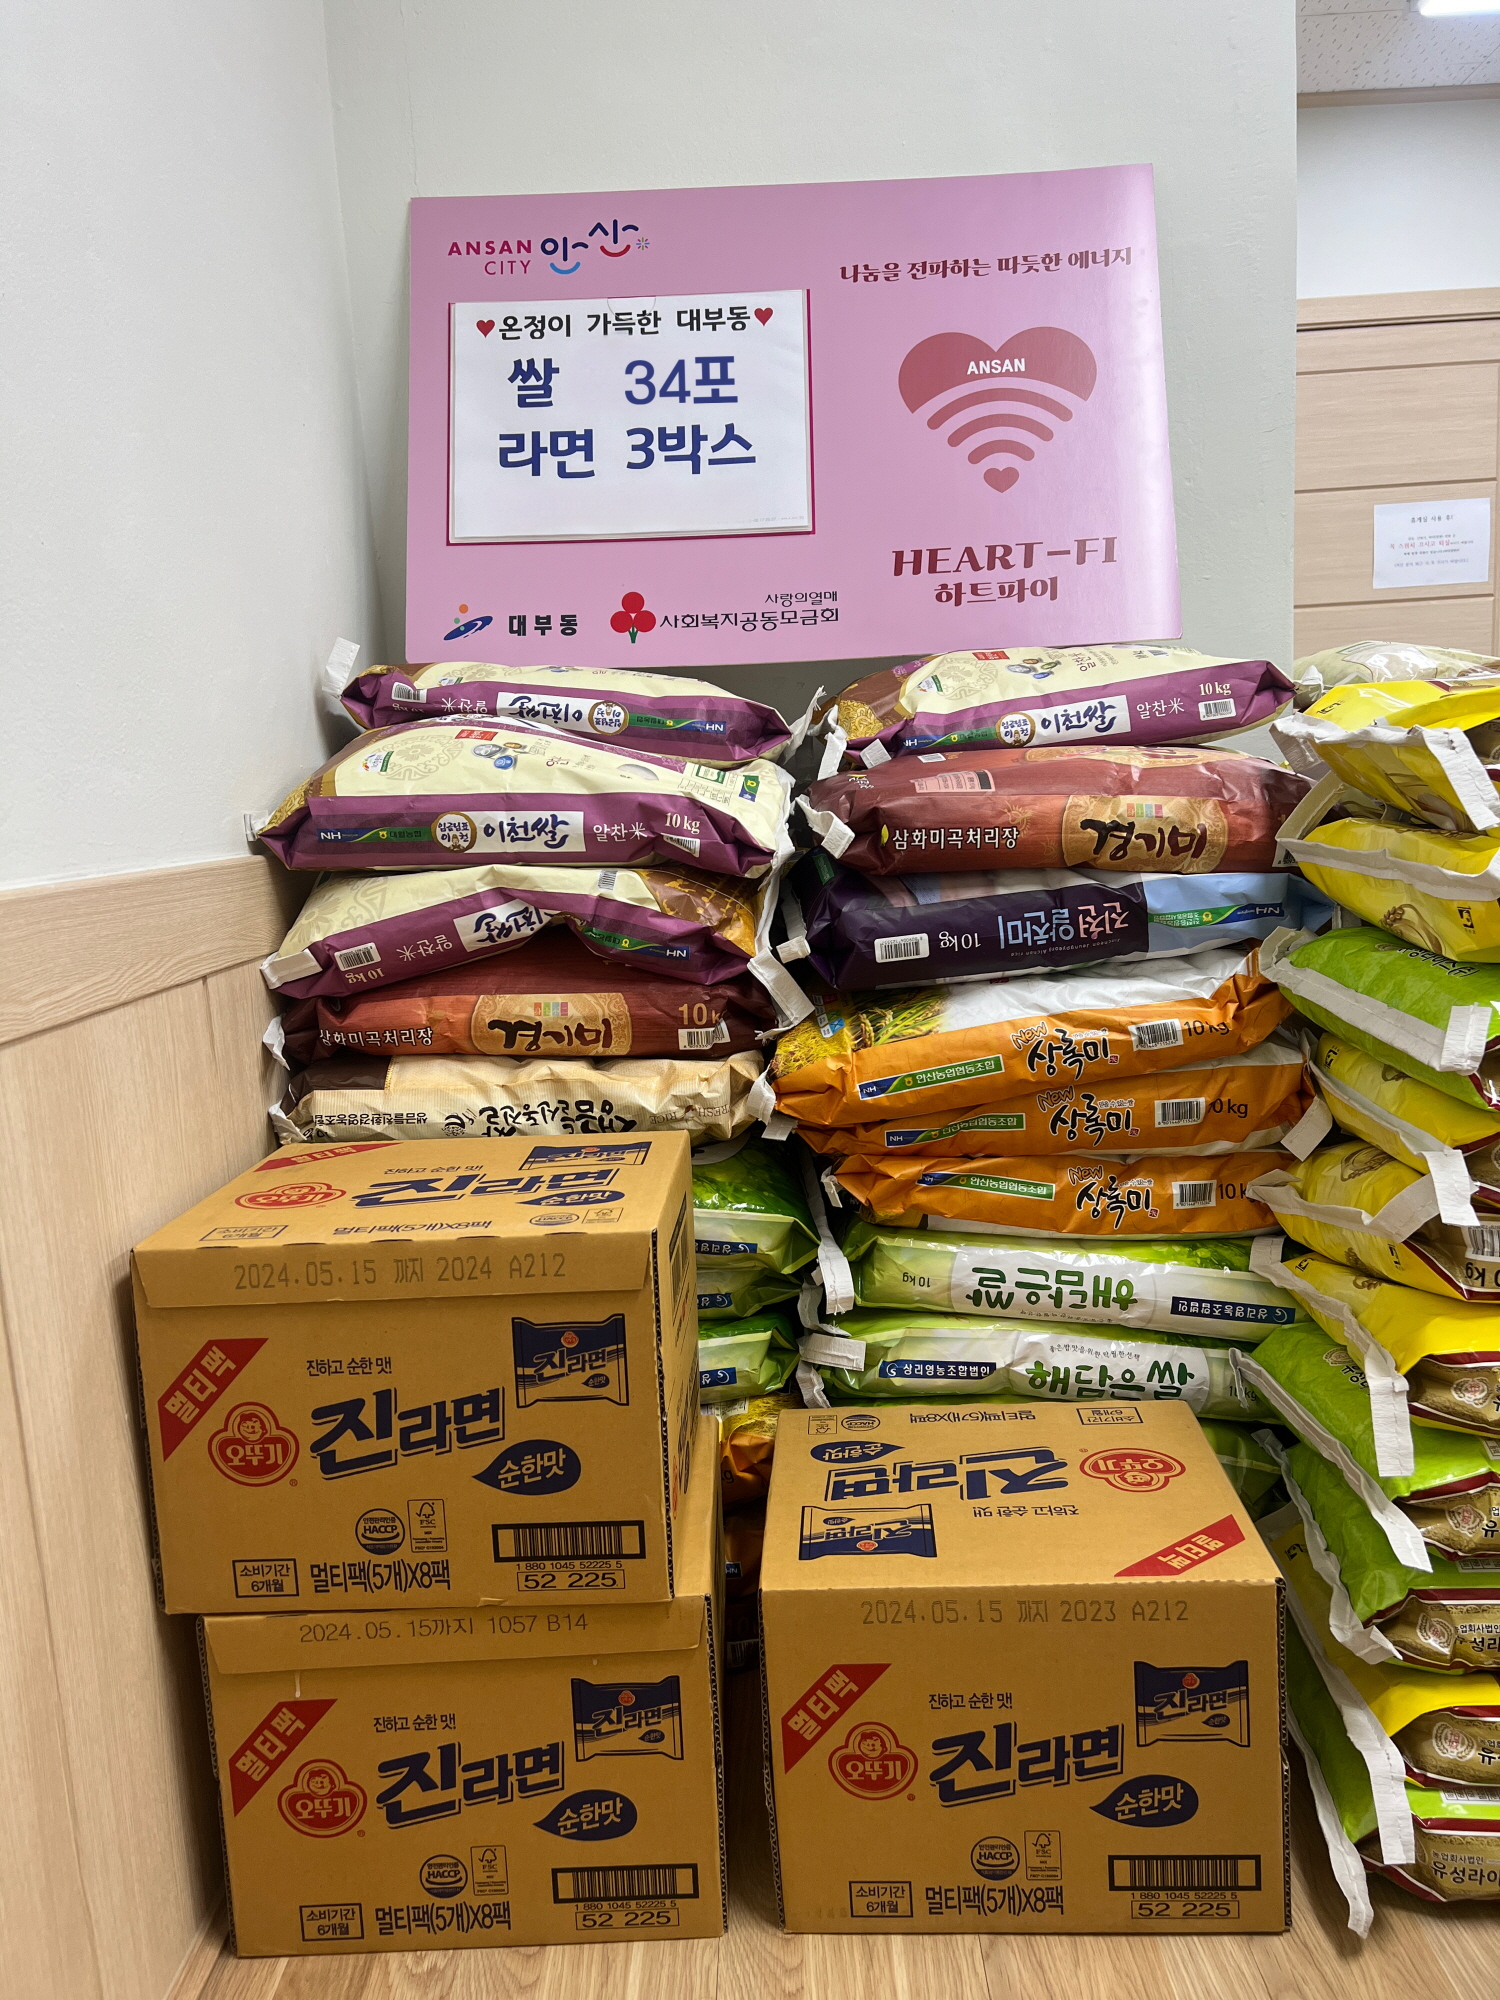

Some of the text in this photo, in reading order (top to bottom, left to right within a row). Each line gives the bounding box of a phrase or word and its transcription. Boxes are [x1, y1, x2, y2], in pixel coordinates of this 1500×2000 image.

[448, 239, 532, 256] ANSAN
[484, 260, 531, 275] CITY
[840, 262, 902, 283] 나눔을
[906, 257, 991, 280] 전파하는
[1068, 246, 1133, 269] 에너지
[498, 306, 750, 340] 온정이 가득한 대부동
[967, 358, 1025, 375] ANSAN
[508, 356, 738, 408] 쌀 34포
[499, 423, 757, 478] 라면 3박스
[892, 536, 1118, 576] HEART-FI
[765, 591, 838, 606] 사랑의열매
[934, 575, 1059, 607] 하트파이
[508, 615, 578, 636] 대부동
[660, 607, 839, 631] 사회복지공동모금회
[1198, 682, 1231, 698] 10 kg
[508, 696, 583, 724] 이천쌀
[1135, 696, 1185, 719] 알찬米
[705, 723, 724, 732] NH
[1040, 702, 1118, 736] 이천쌀
[483, 815, 570, 849] 이천쌀
[592, 821, 648, 841] 알찬米
[682, 815, 701, 833] kg
[320, 832, 341, 840] NH
[892, 827, 1020, 851] 삼화미곡처리장
[1080, 818, 1208, 861] 경기미
[1255, 906, 1280, 915] NH
[998, 902, 1130, 949] 진천 알찬미
[396, 933, 454, 963] 알찬米
[938, 931, 981, 952] 10 kg
[666, 948, 688, 959] NH
[346, 966, 386, 986] 10 kg
[679, 1003, 708, 1026] 10
[319, 1028, 433, 1048] 삼화미곡처리장
[488, 1018, 613, 1051] 경기미
[1012, 1022, 1048, 1048] New
[1184, 1020, 1204, 1037] 10
[1027, 1028, 1110, 1080] 상록미
[915, 1058, 995, 1085] 안산농업협동조합
[862, 1085, 877, 1095] NH
[1038, 1085, 1075, 1111] New
[649, 1111, 677, 1125] RICE
[1227, 1100, 1248, 1118] kg
[1049, 1092, 1131, 1148] 상록미
[889, 1135, 903, 1143] NH
[1069, 1165, 1103, 1184] New
[350, 1168, 620, 1210] 진라면
[969, 1175, 1048, 1197] 안산농업협동조합
[1218, 1183, 1236, 1200] 10
[540, 1191, 613, 1206] 순한맛
[1076, 1175, 1151, 1230] 상록미
[233, 1253, 567, 1290] 2024.05.15 까지 2024 A212
[902, 1271, 931, 1288] 10 kg
[964, 1266, 1138, 1312] 해담은쌀
[1176, 1299, 1268, 1322] 상리영농조합법인
[306, 1357, 373, 1377] 진하고 순한
[532, 1348, 607, 1382] 진라면
[902, 1363, 991, 1379] 상리영농조합법인
[163, 1346, 237, 1424] 멀티팩
[1027, 1359, 1195, 1401] 해담은쌀
[1244, 1386, 1257, 1401] kg
[310, 1386, 505, 1480] 진라면
[225, 1444, 284, 1466] 오뚜기
[822, 1442, 884, 1461] 순한맛
[498, 1450, 567, 1490] 순한맛
[825, 1446, 1070, 1502] 진라면
[1099, 1457, 1163, 1473] 오뚜기
[996, 1504, 1080, 1518] 진하고 순한
[363, 1525, 398, 1534] HACCP
[825, 1520, 912, 1541] 진라면
[1157, 1533, 1226, 1571] 멀티팩
[240, 1563, 290, 1578] 소비기간
[525, 1561, 612, 1570] 880 1045 52225
[250, 1577, 284, 1594] 6개월
[310, 1558, 451, 1596] 멀티팩(5개)X8팩
[523, 1573, 556, 1589] 52
[861, 1600, 1189, 1626] 2024.05.15 까지 2023 A212
[488, 1614, 588, 1635] 1057 B14
[787, 1669, 860, 1741] 멀티팩
[928, 1692, 995, 1710] 진하고 순한
[1153, 1689, 1229, 1722] 진라면
[374, 1714, 438, 1732] 진하고 순한
[591, 1705, 664, 1738] 진라면
[235, 1707, 306, 1782] 멀티팩
[845, 1759, 902, 1782] 오뚜기
[929, 1721, 1124, 1808] 진라면
[376, 1741, 564, 1830] 진라면
[295, 1799, 351, 1820] 오뚜기
[1114, 1783, 1184, 1821] 순한맛
[557, 1798, 623, 1836] 순한맛
[979, 1852, 1013, 1861] HACCP
[427, 1869, 461, 1879] HACCP
[855, 1885, 906, 1899] 소비기간
[926, 1884, 1064, 1917] 멀티팩(5개)X8팩
[1140, 1892, 1228, 1901] 880 1045 52225
[306, 1907, 356, 1922] 소비기간
[583, 1902, 668, 1911] 880 1045 52225
[866, 1899, 899, 1915] 6개월
[1139, 1901, 1232, 1918] 52 225
[374, 1901, 512, 1936] 멀티팩(5개)X8팩
[581, 1911, 672, 1929] 52 225
[317, 1921, 350, 1938] 6개월
